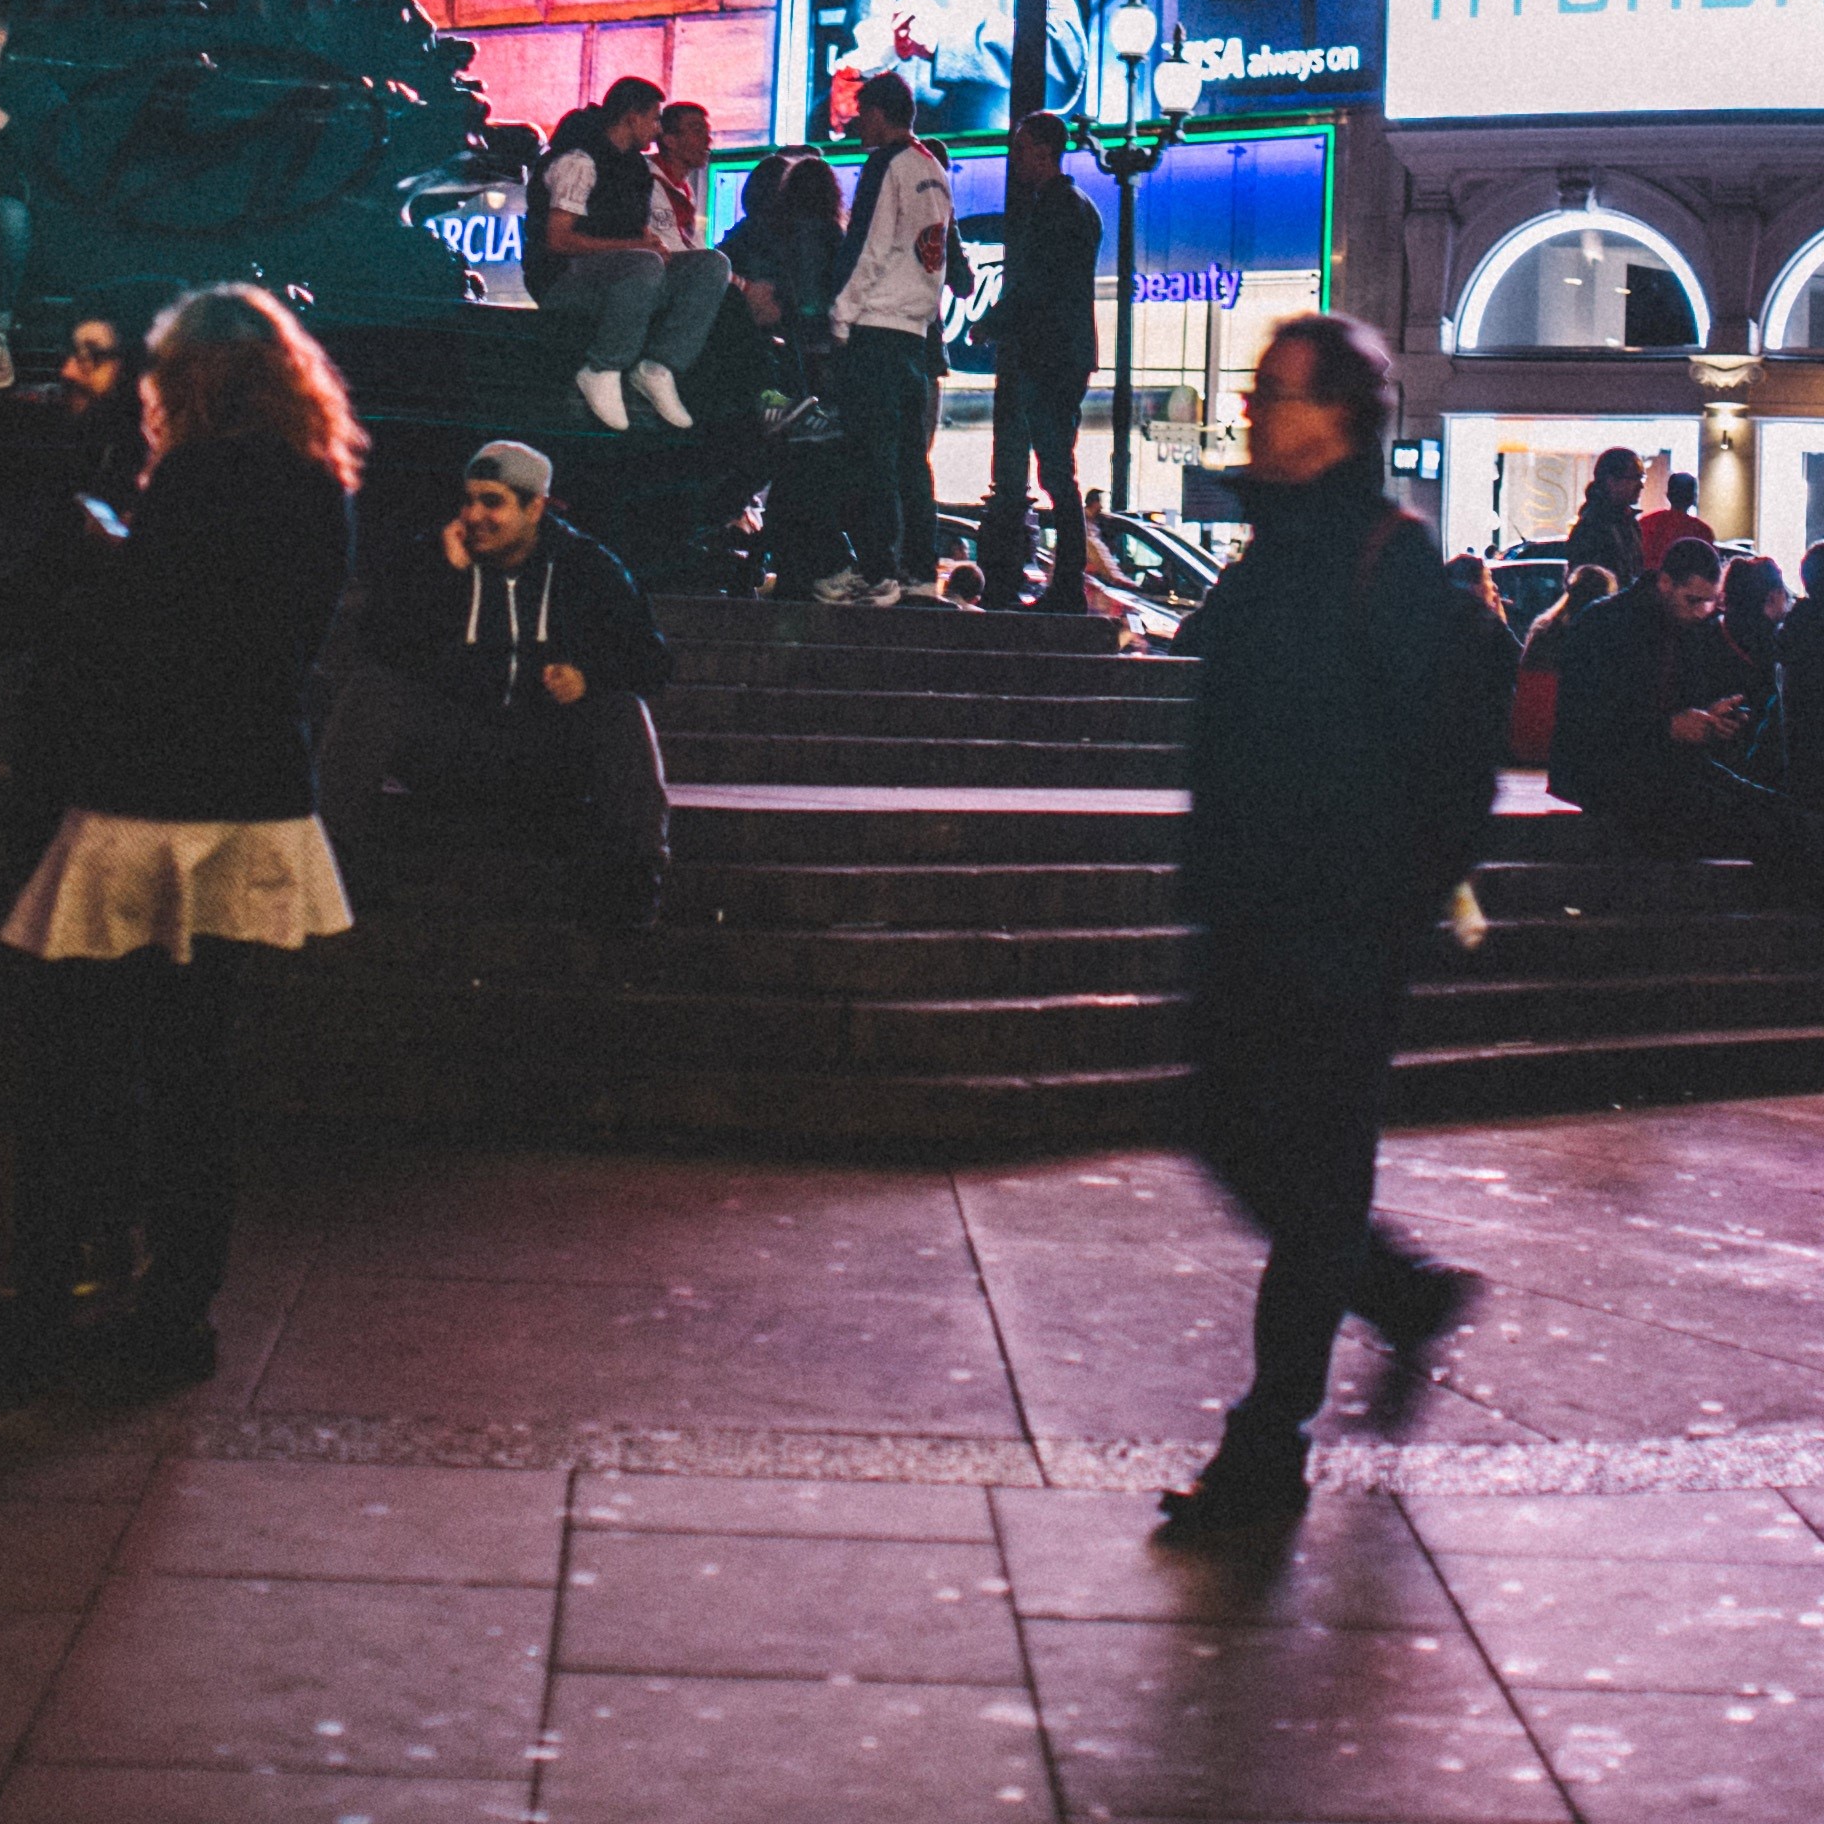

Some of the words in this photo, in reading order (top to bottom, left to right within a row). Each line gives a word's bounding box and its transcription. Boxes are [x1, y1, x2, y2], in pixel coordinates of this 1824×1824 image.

[1246, 44, 1325, 82] always
[1326, 45, 1360, 72] on
[423, 209, 526, 264] RCLA
